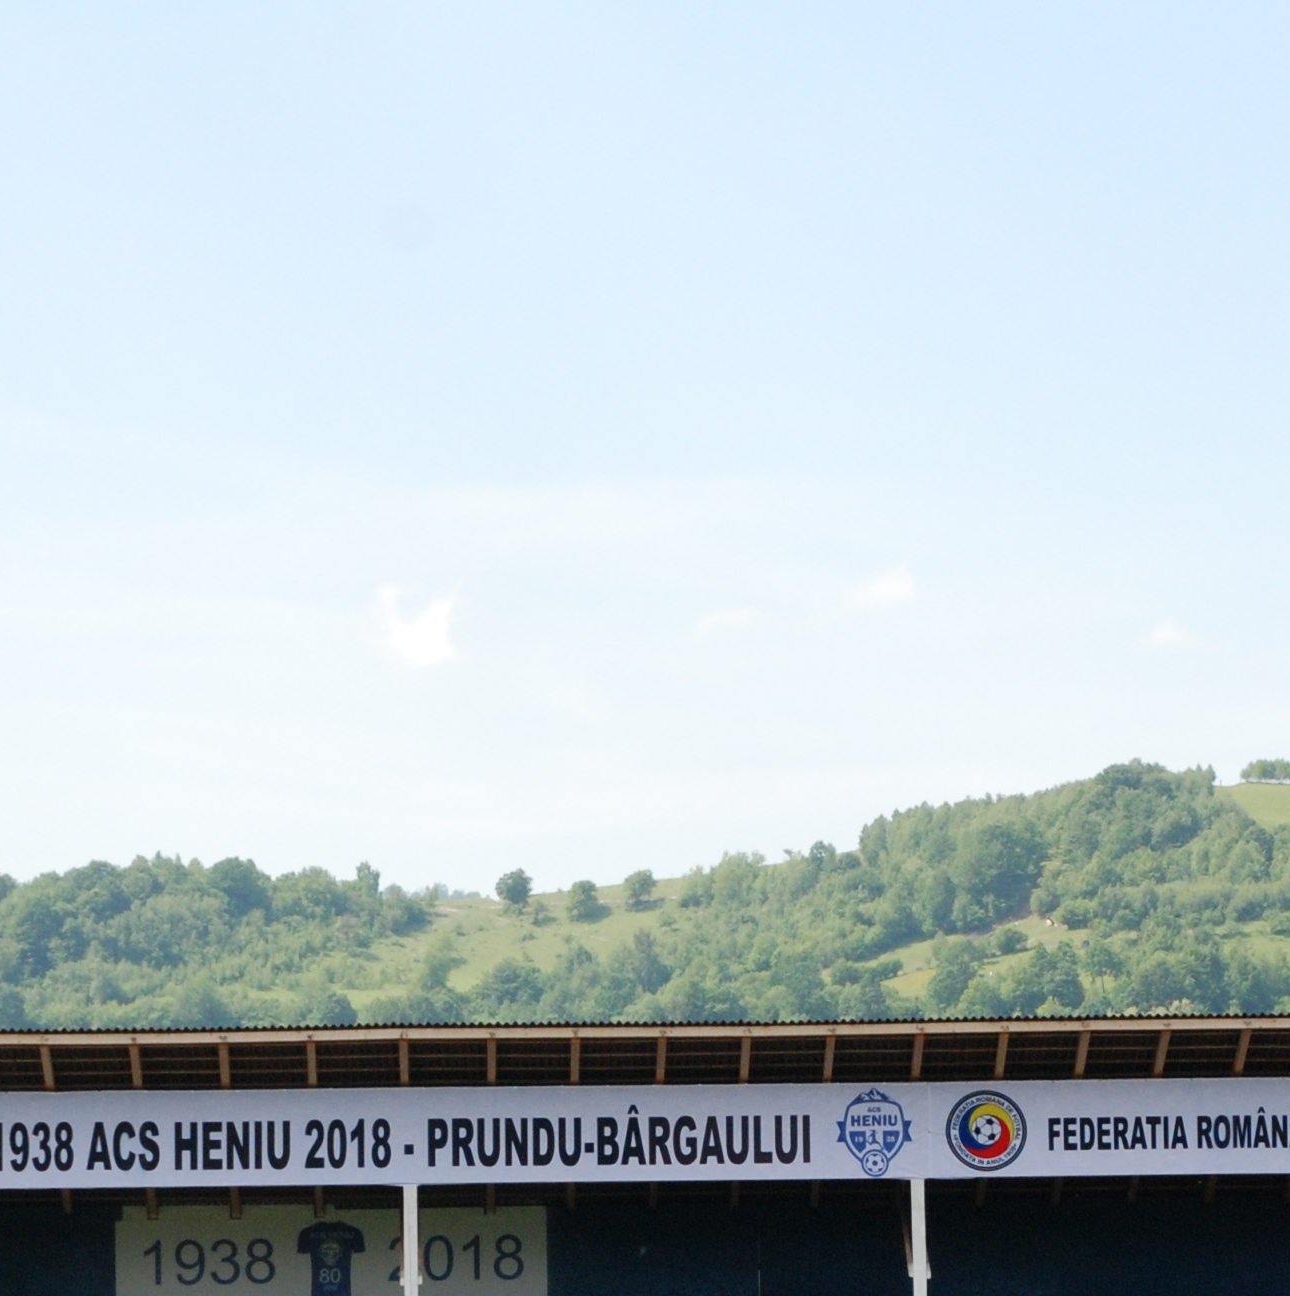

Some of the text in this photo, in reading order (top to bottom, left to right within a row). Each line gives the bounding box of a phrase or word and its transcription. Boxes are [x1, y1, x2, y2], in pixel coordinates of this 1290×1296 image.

[86, 1120, 160, 1171] ACS
[174, 1120, 291, 1171] HENIU
[304, 1118, 392, 1169] 2018
[428, 1105, 811, 1167] PRUNDU-BÂRGAULUI
[851, 1115, 898, 1126] HENIU
[1048, 1115, 1188, 1151] FEDERATIA
[142, 1238, 276, 1286] 1938
[319, 1268, 341, 1284] 80
